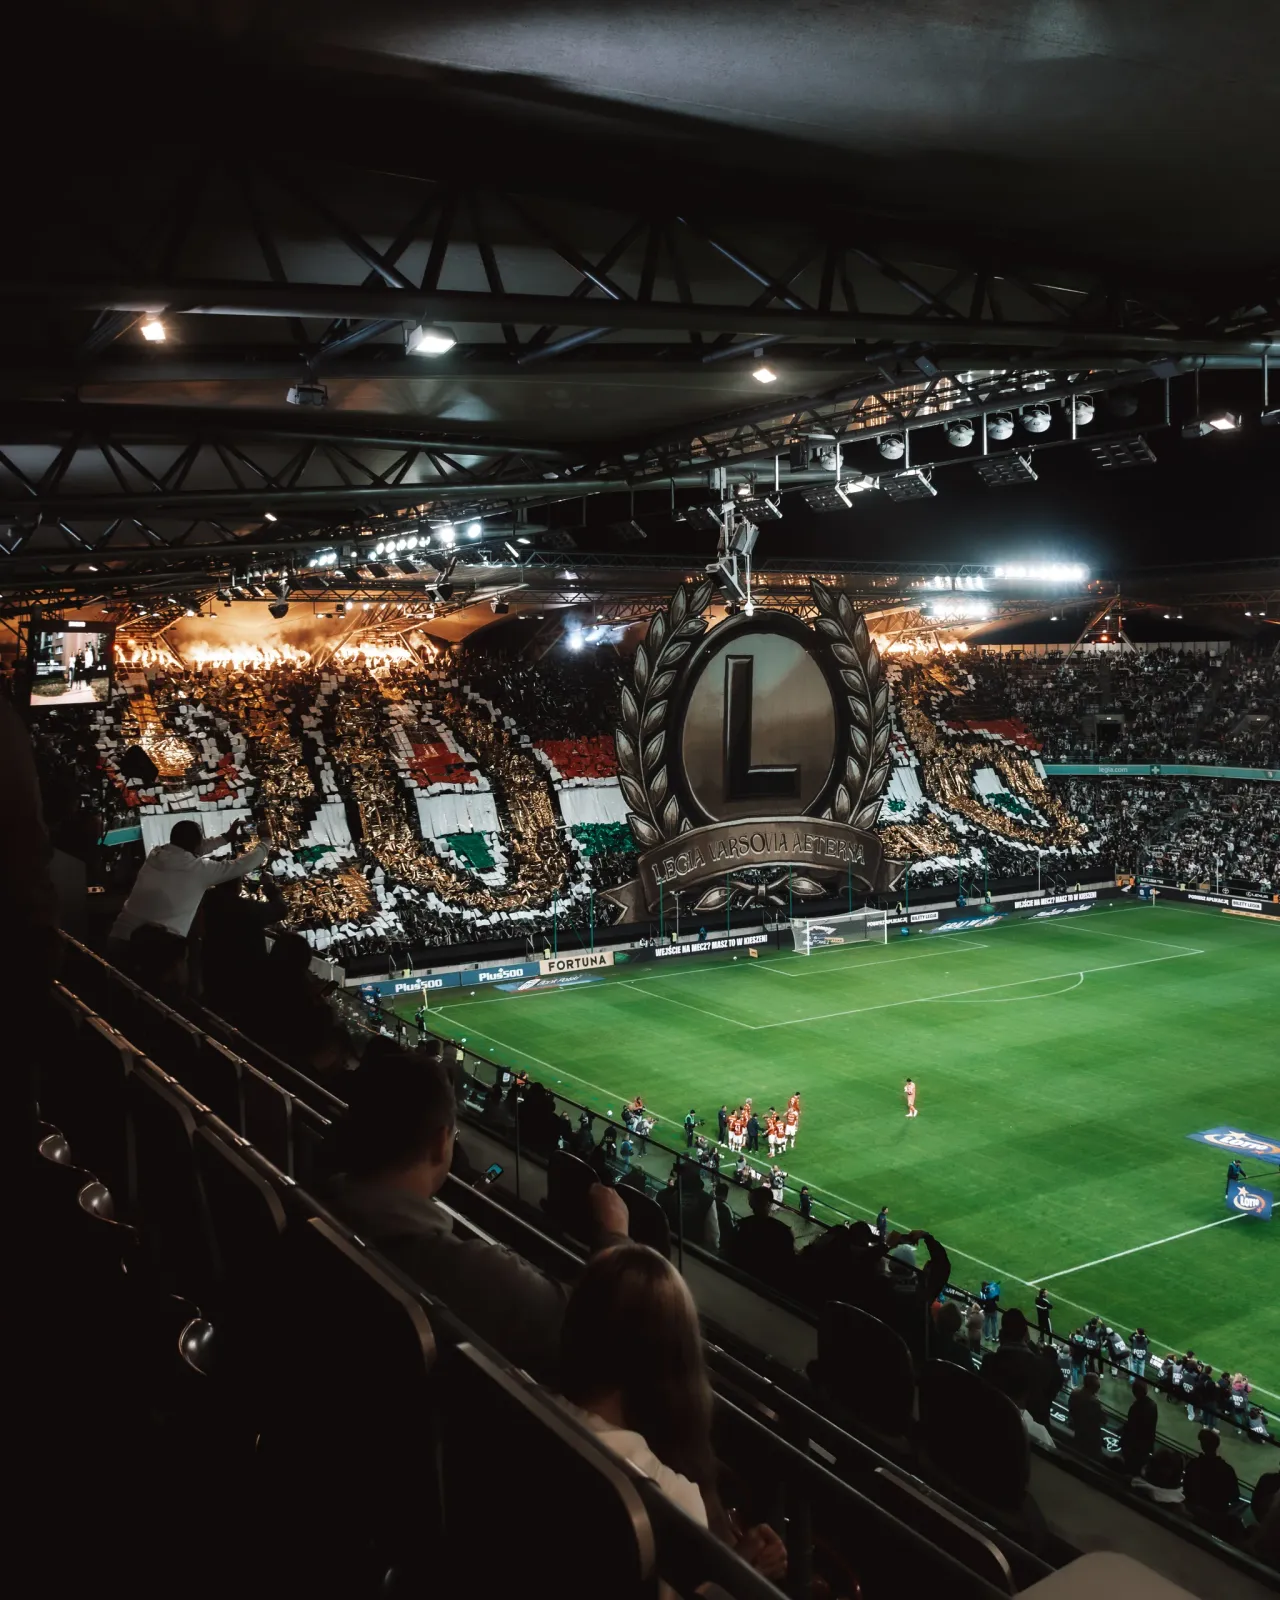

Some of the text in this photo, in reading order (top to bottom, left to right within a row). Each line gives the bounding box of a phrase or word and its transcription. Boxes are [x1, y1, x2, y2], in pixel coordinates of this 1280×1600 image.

[724, 655, 801, 802] L
[1098, 765, 1128, 774] legia.com
[651, 832, 866, 885] LEGIA VARSOVIA AETERNA
[655, 945, 681, 958] WEJŚCIE
[681, 944, 691, 954] NA
[691, 941, 711, 952] MECZ?
[711, 940, 728, 950] MASZ
[728, 939, 736, 947] TO
[736, 938, 743, 946] W
[548, 955, 606, 972] FORTUNA
[479, 967, 523, 982] Plus500
[395, 978, 443, 993] Plus500
